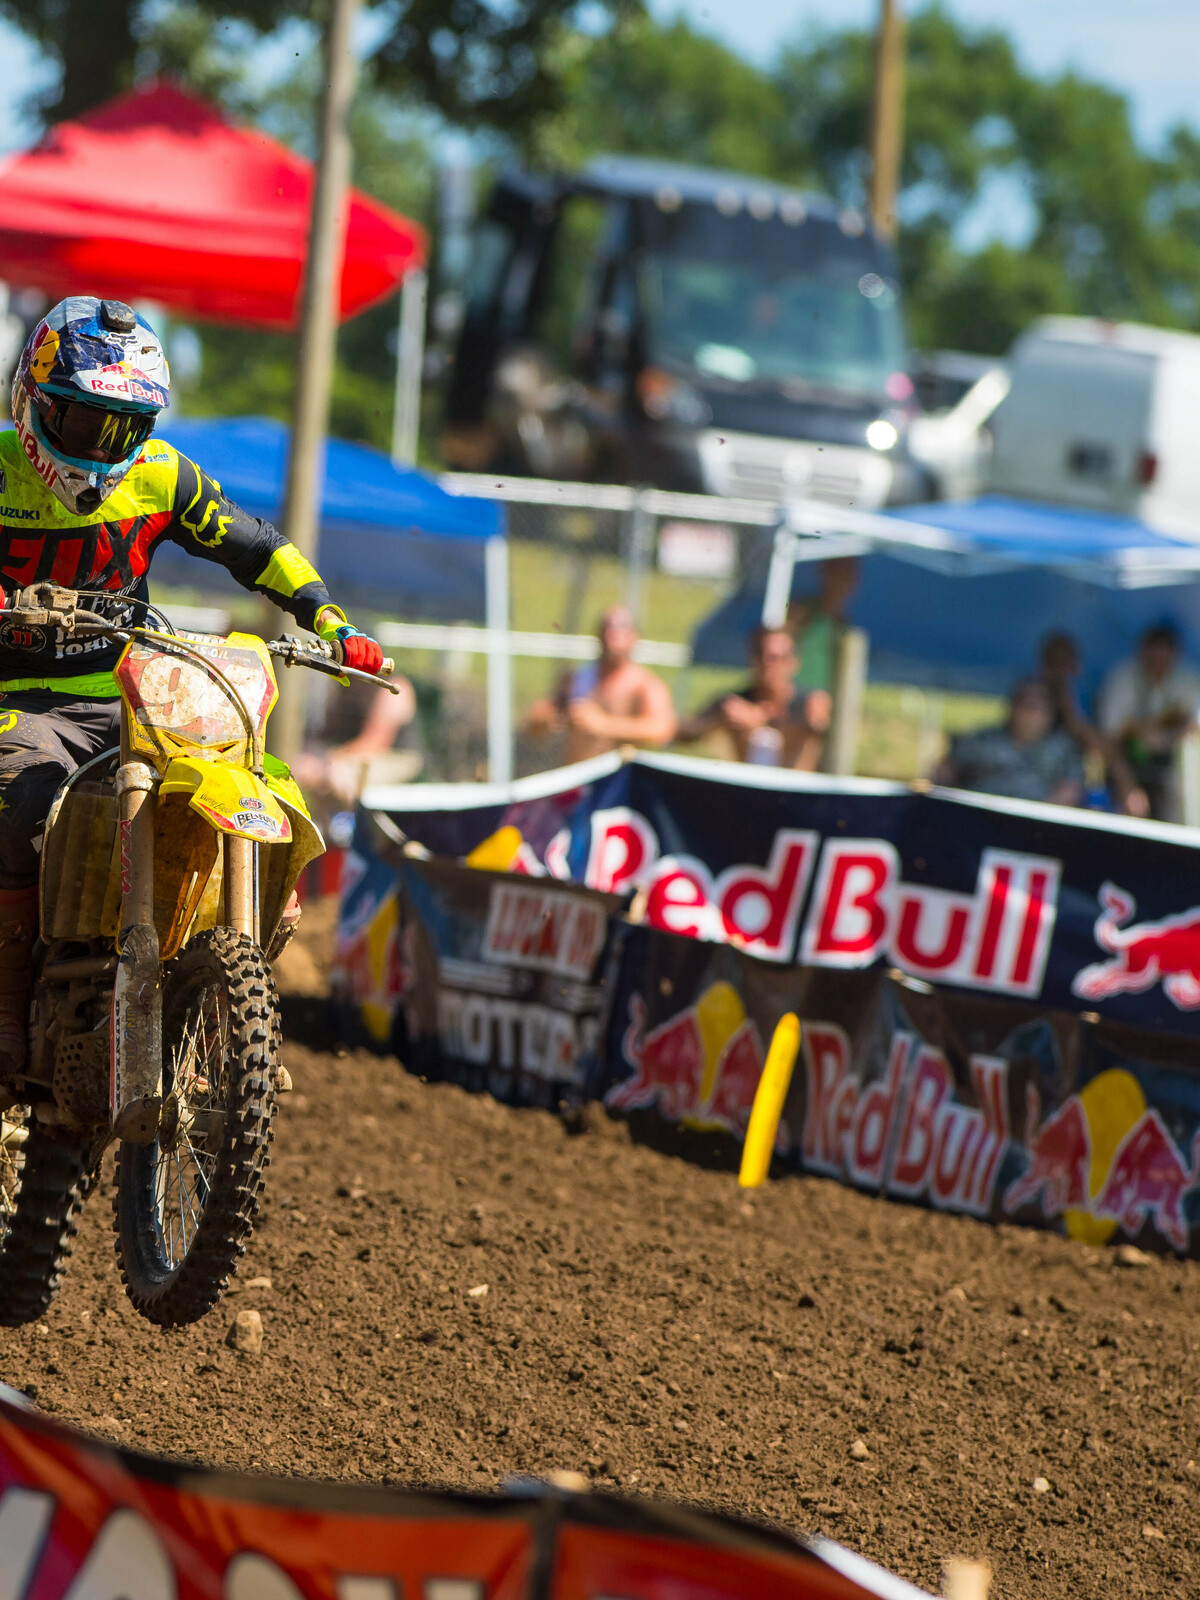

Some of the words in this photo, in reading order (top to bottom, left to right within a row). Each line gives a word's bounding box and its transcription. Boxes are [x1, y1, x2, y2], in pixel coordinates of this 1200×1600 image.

[91, 379, 130, 394] Red
[131, 382, 165, 406] Bull
[801, 838, 1062, 996] Bull
[802, 1022, 912, 1190] Red
[887, 1045, 1008, 1215] Bull
